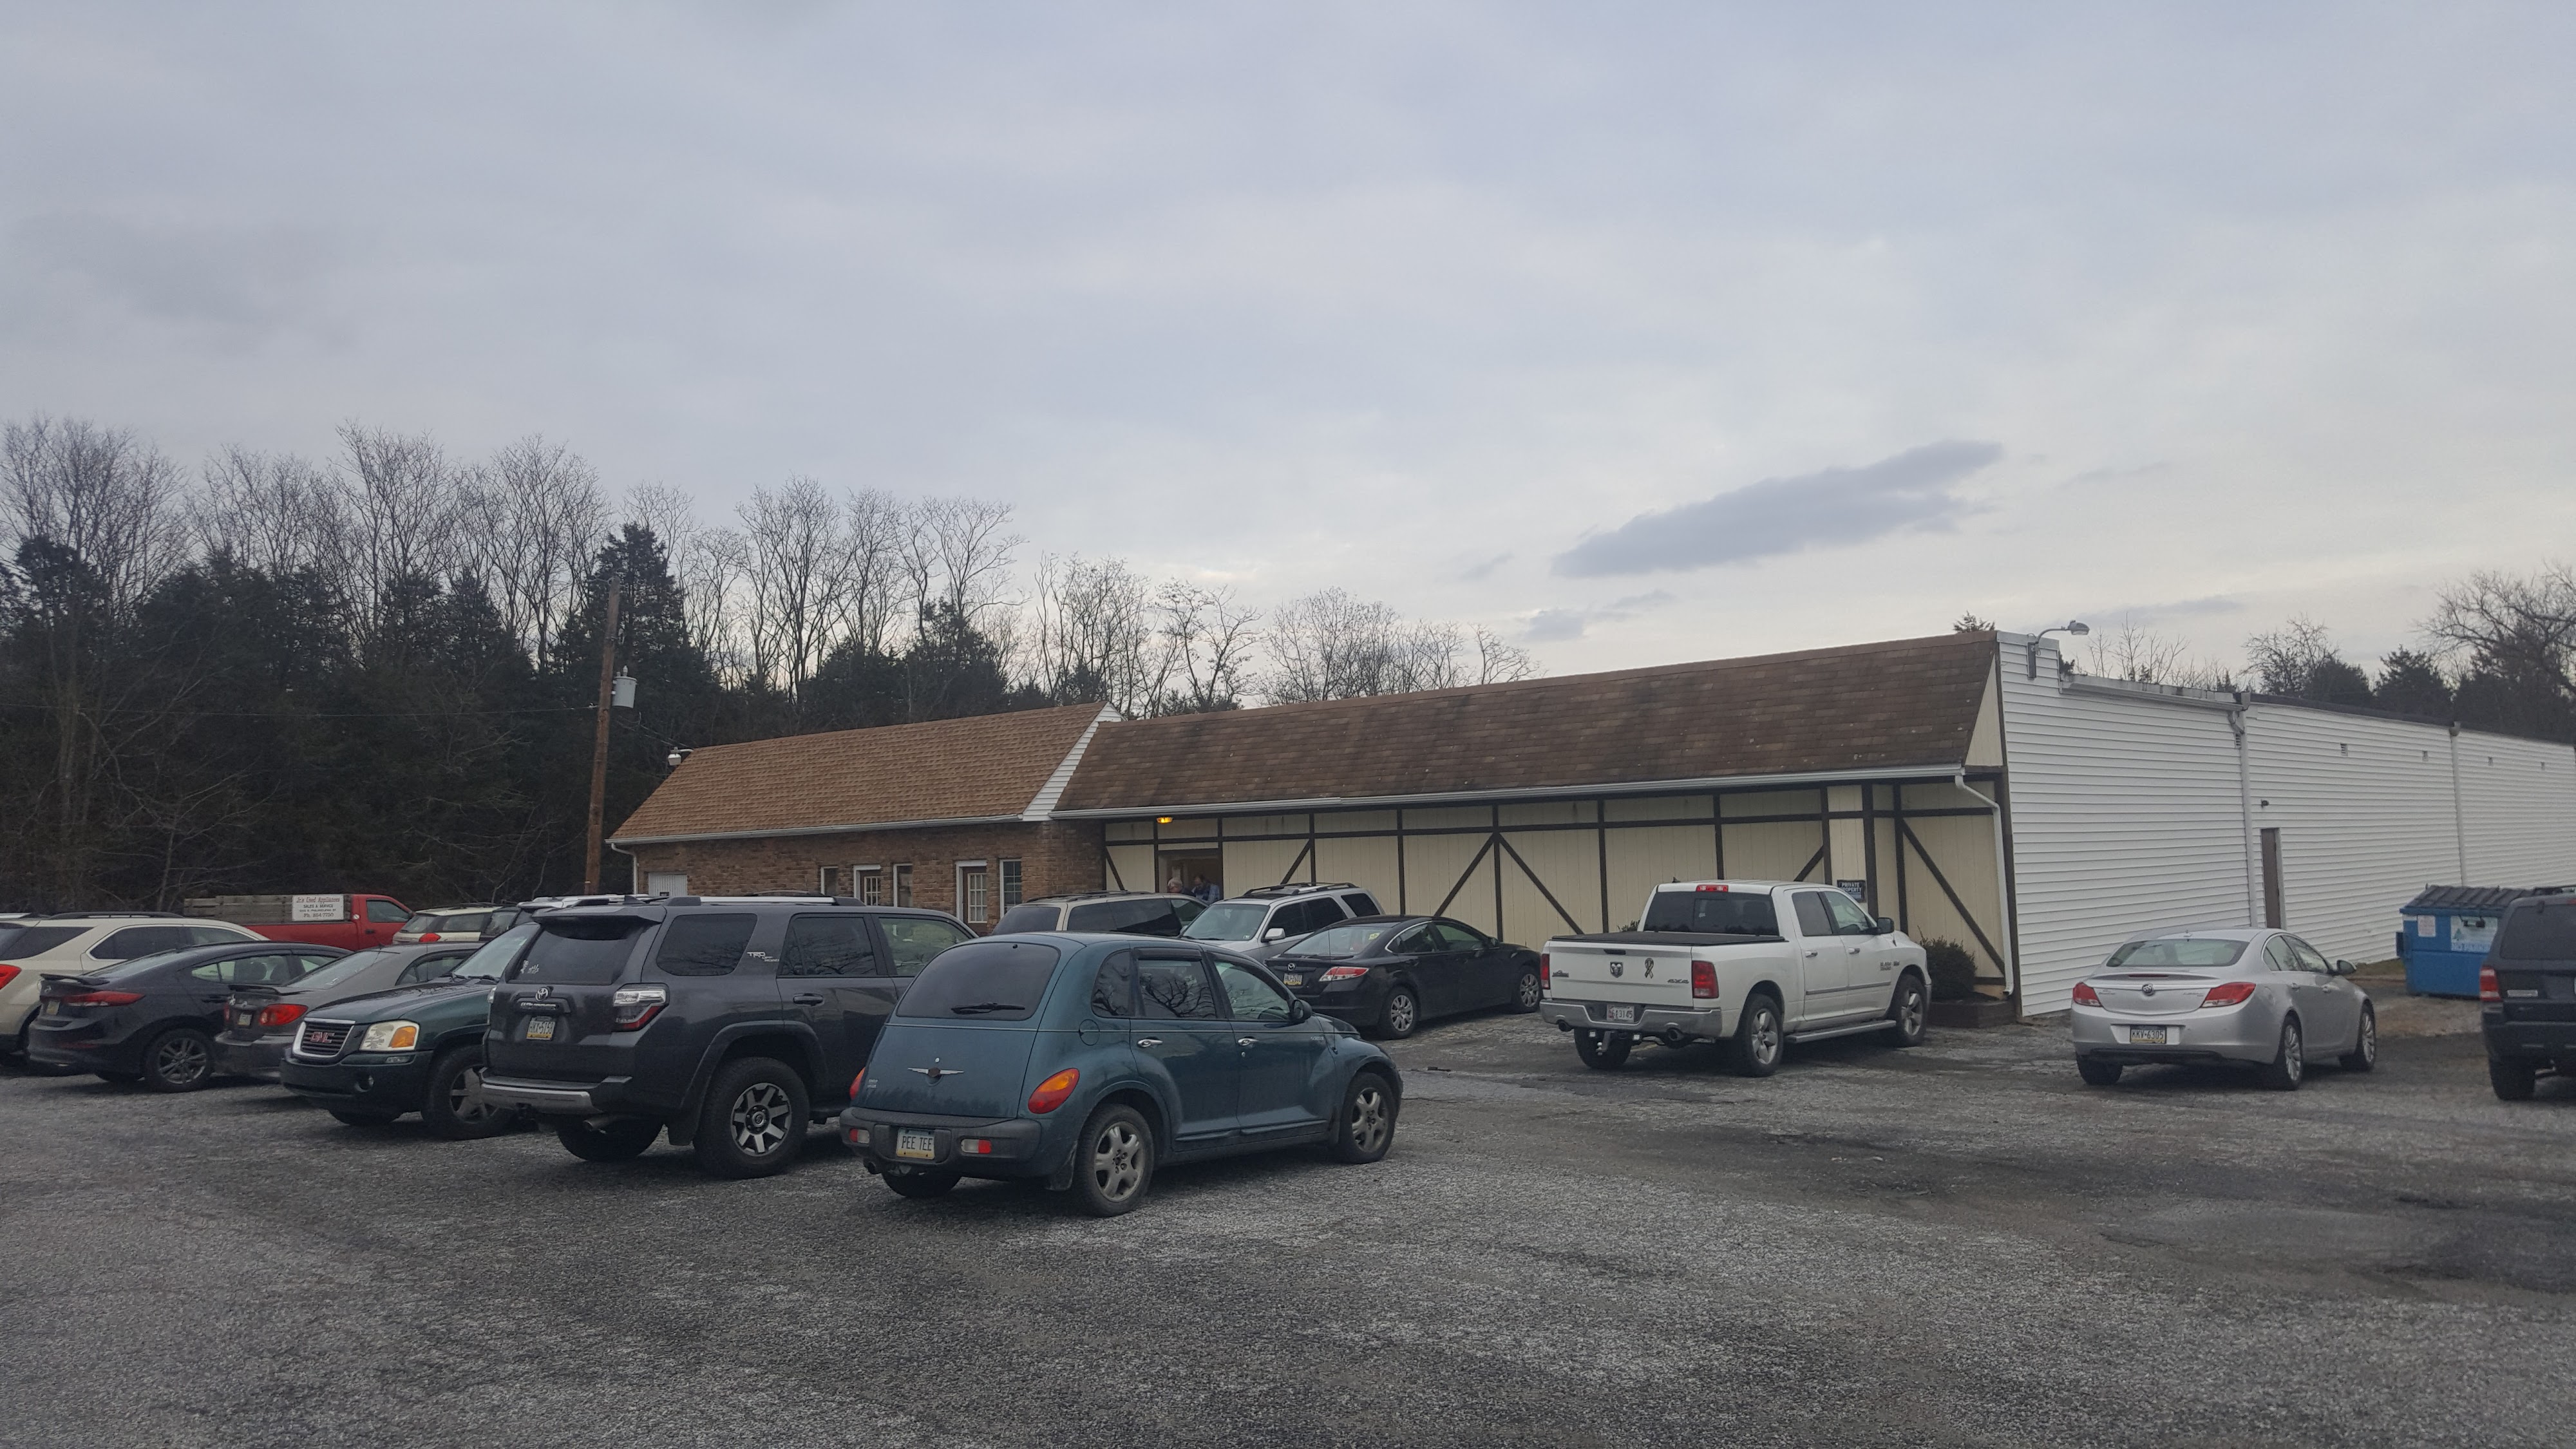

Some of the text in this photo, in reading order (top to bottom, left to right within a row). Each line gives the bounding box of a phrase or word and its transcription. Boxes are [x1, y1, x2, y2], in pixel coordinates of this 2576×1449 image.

[310, 1031, 335, 1043] GMC
[902, 1135, 933, 1151] PEE TEE
